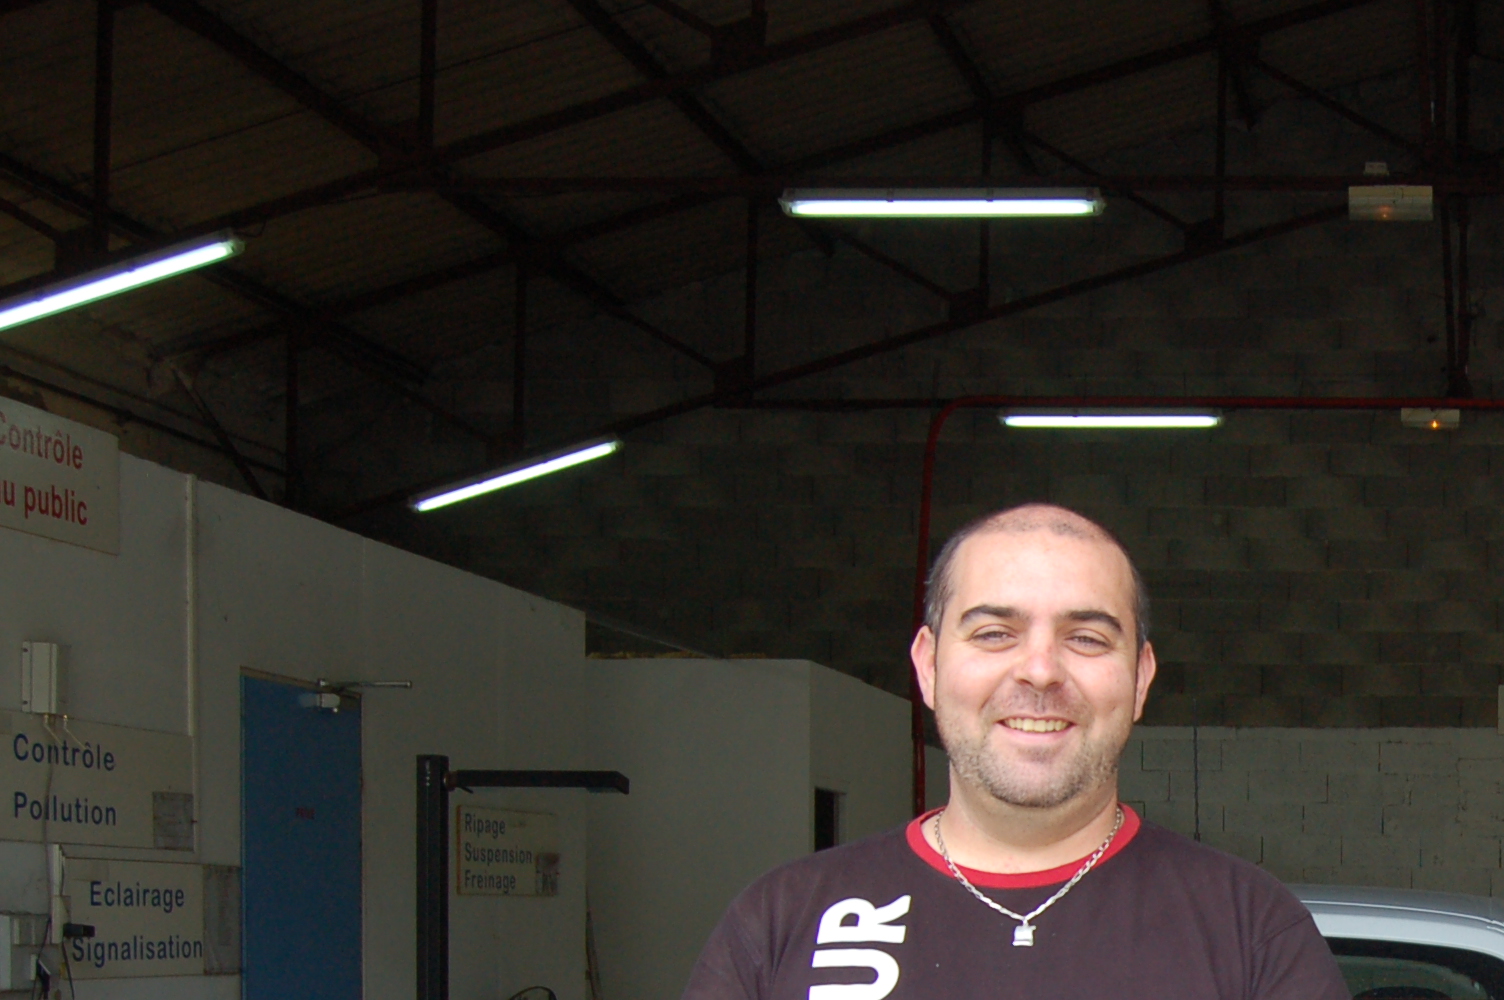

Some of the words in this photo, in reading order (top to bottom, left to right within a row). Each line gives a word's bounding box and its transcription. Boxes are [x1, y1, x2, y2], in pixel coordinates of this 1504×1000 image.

[24, 484, 88, 525] public
[13, 733, 116, 771] Contrôle
[14, 791, 117, 826] Pollution
[464, 813, 506, 839] Ripage
[464, 842, 533, 867] Suspension
[90, 881, 185, 913] Eclairage
[464, 869, 517, 895] Freinage
[72, 935, 203, 968] Signalisation
